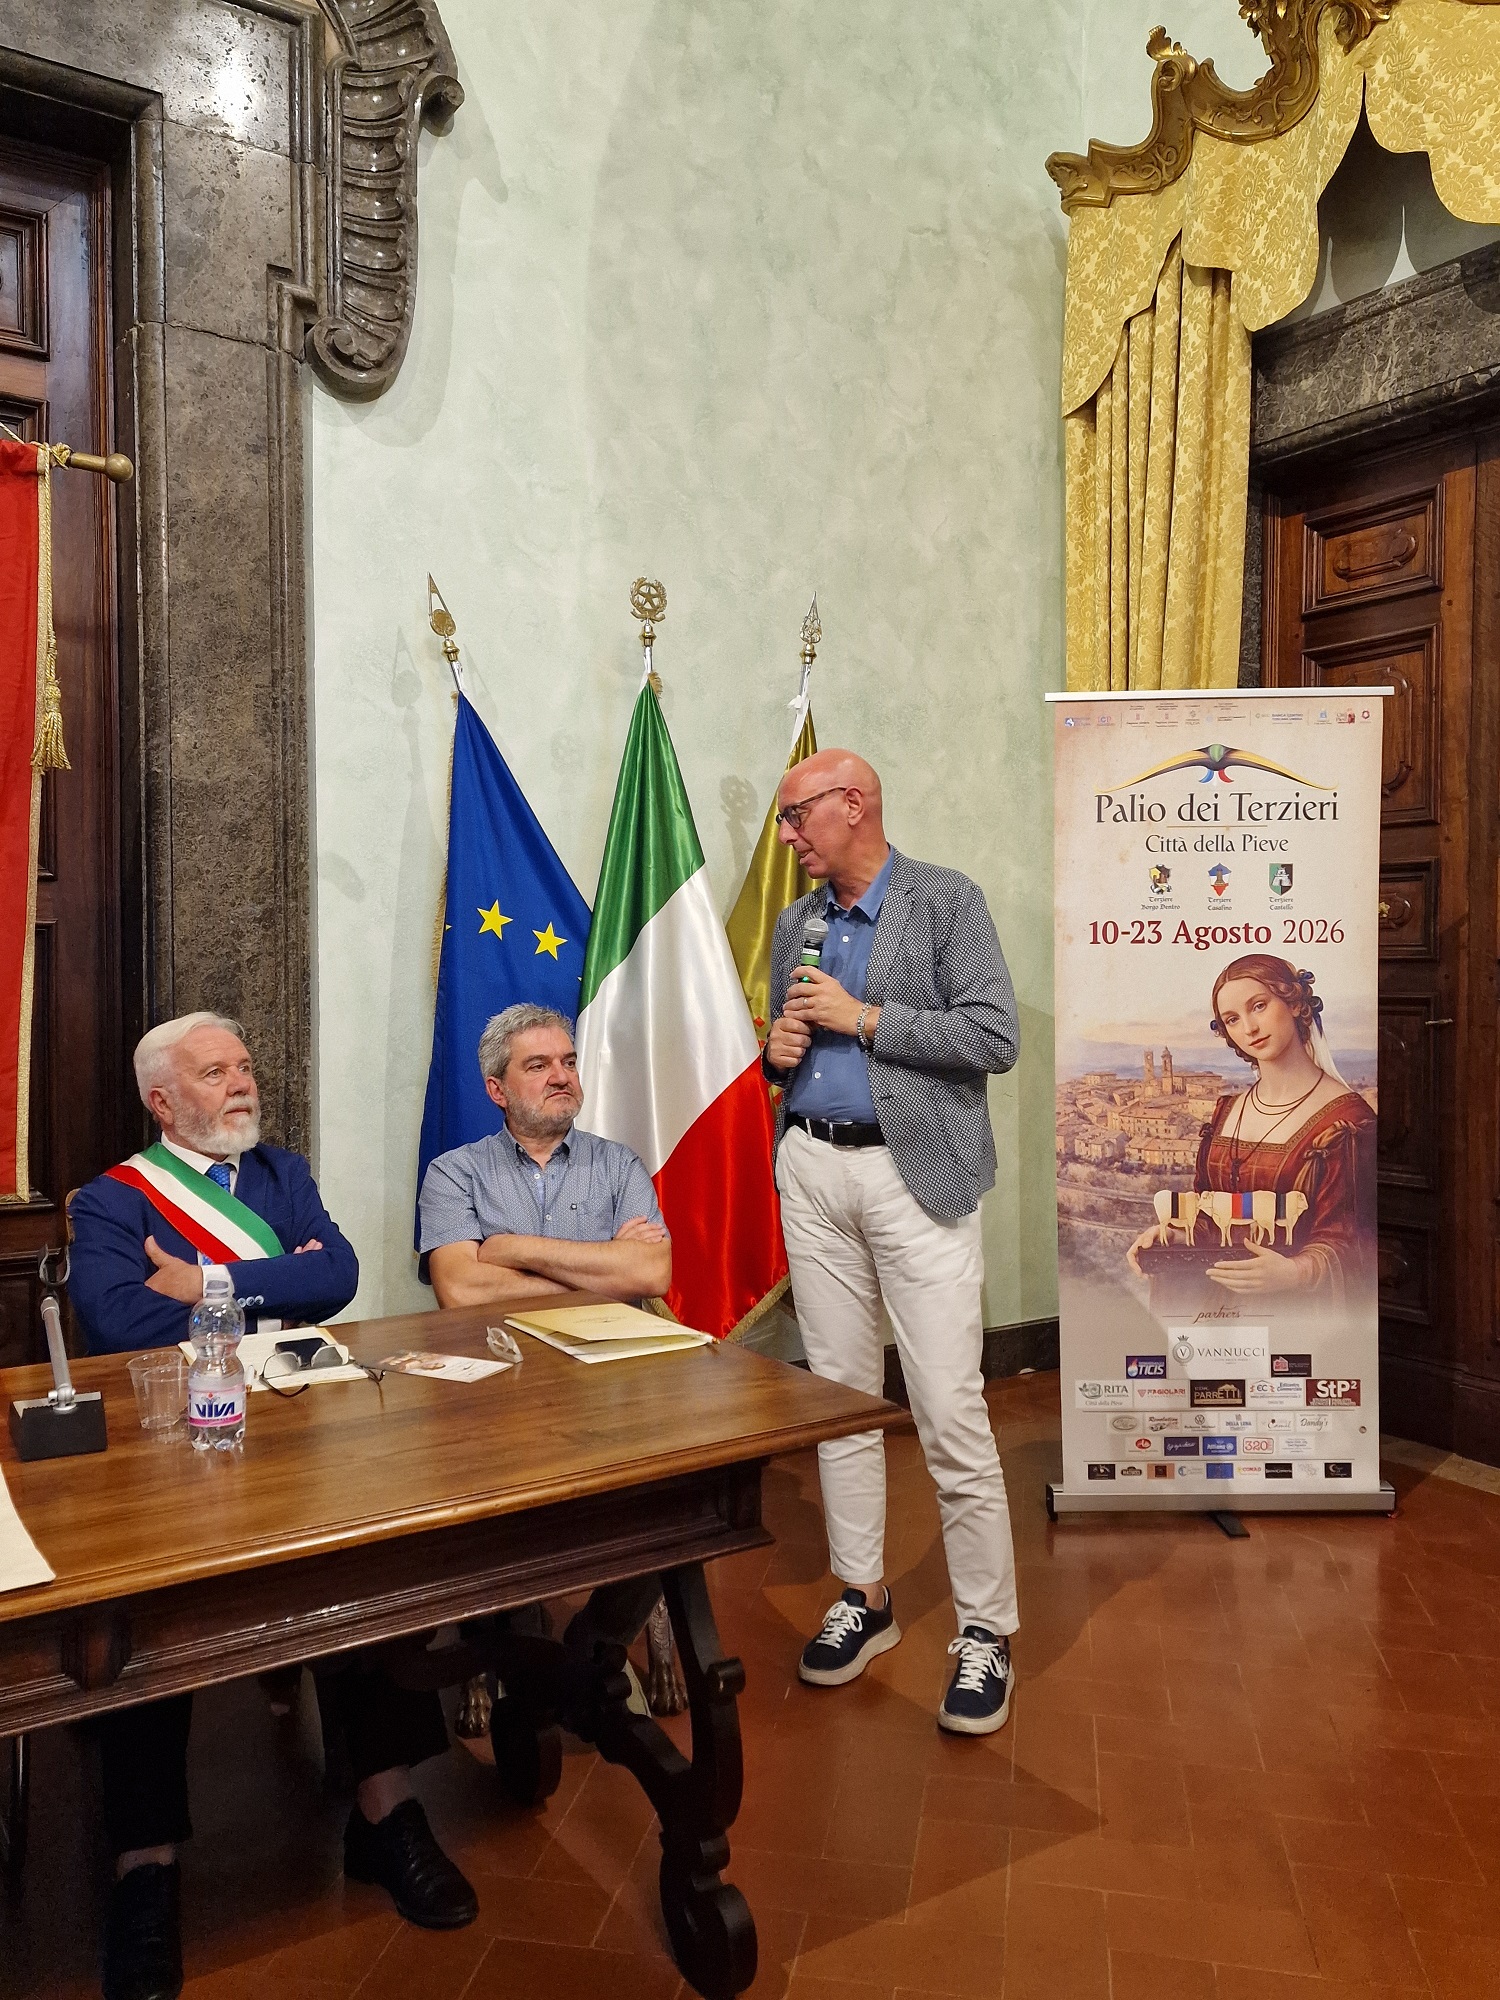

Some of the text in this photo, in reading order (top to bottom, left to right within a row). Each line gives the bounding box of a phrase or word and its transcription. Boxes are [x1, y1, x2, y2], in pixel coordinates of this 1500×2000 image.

[1095, 792, 1339, 823] Palio dei Terzieri
[1145, 834, 1289, 853] Città della Pieve
[1088, 919, 1345, 950] 10-23 Agosto 2026
[1193, 1305, 1242, 1324] partners
[1197, 1347, 1266, 1357] VANNUCCI
[1138, 1364, 1164, 1376] TICIS
[1104, 1385, 1129, 1394] RITA
[1194, 1389, 1240, 1399] PARRETTI
[195, 1400, 235, 1418] VIVA
[1300, 1418, 1328, 1431] Dandy's
[1244, 1440, 1268, 1451] 320
